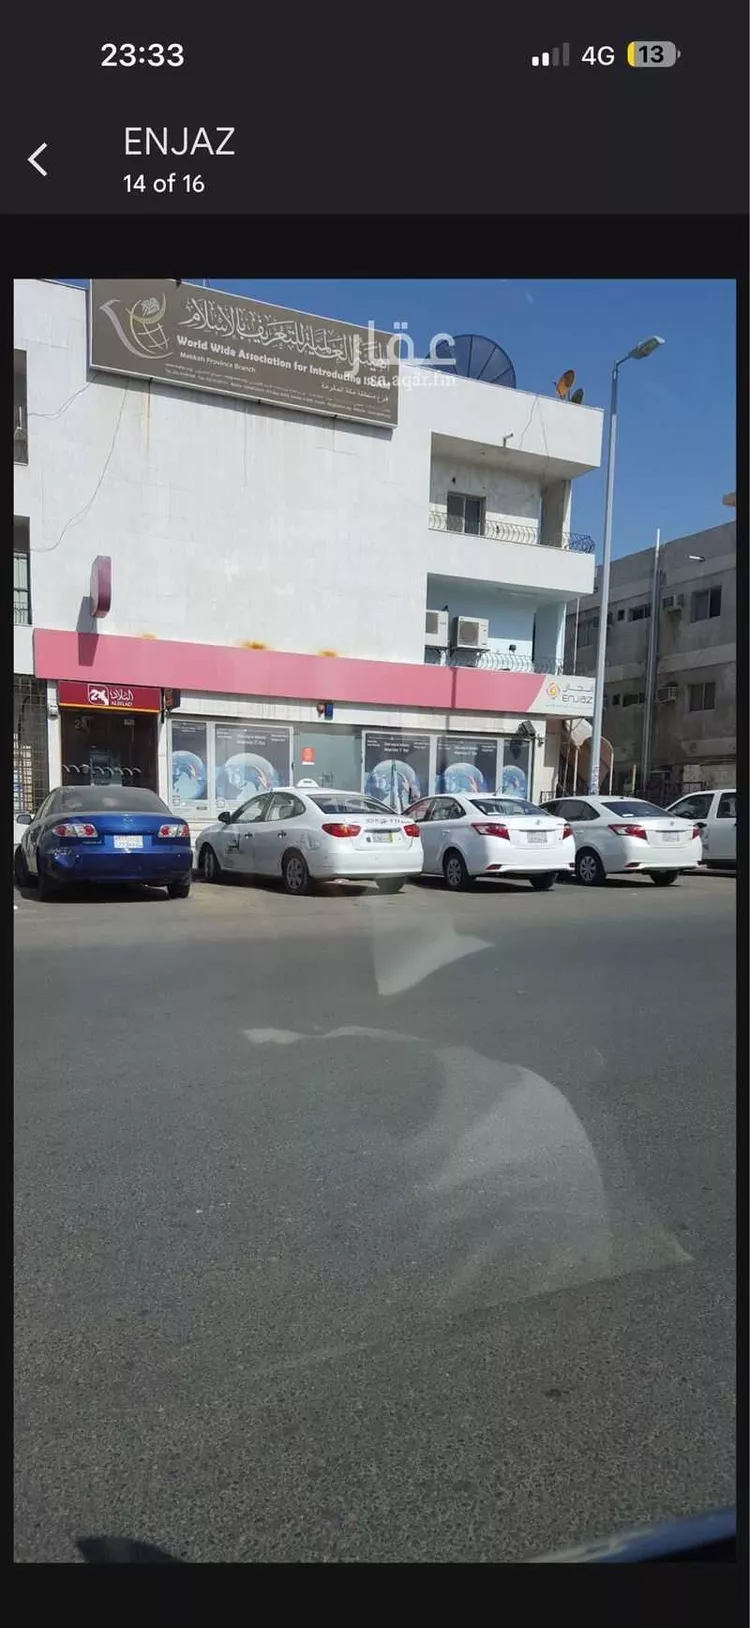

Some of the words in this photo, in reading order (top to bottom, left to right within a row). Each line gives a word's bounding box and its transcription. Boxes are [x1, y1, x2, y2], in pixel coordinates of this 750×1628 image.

[176, 335, 208, 351] World
[210, 341, 237, 357] Wide
[239, 349, 292, 370] Association
[293, 361, 308, 373] for
[309, 364, 361, 385] Introducing
[206, 356, 233, 369] Province
[234, 363, 256, 374] Branch
